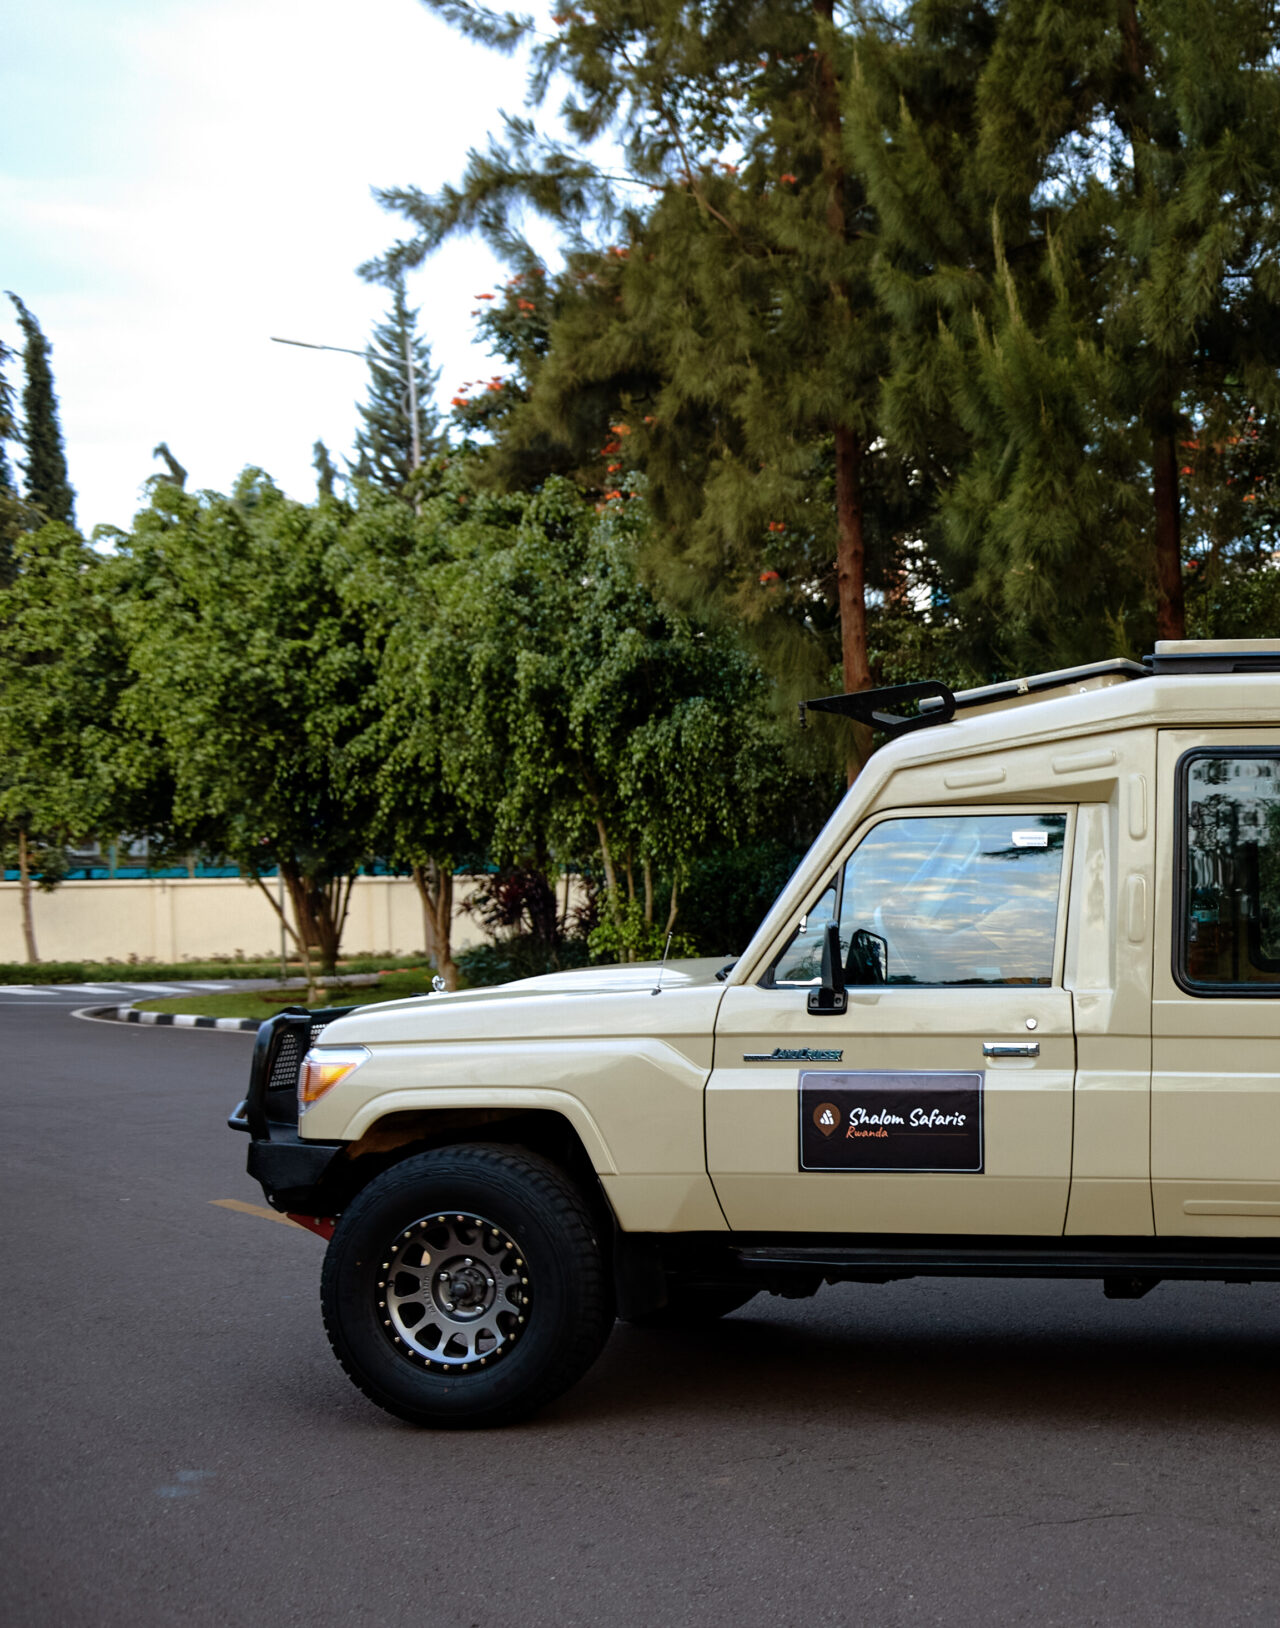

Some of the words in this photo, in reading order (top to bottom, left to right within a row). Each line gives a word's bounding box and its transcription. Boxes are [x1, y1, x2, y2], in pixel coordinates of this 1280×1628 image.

[848, 1107, 905, 1127] Shalom
[909, 1107, 967, 1128] Safaris
[845, 1126, 889, 1138] Rwanda
